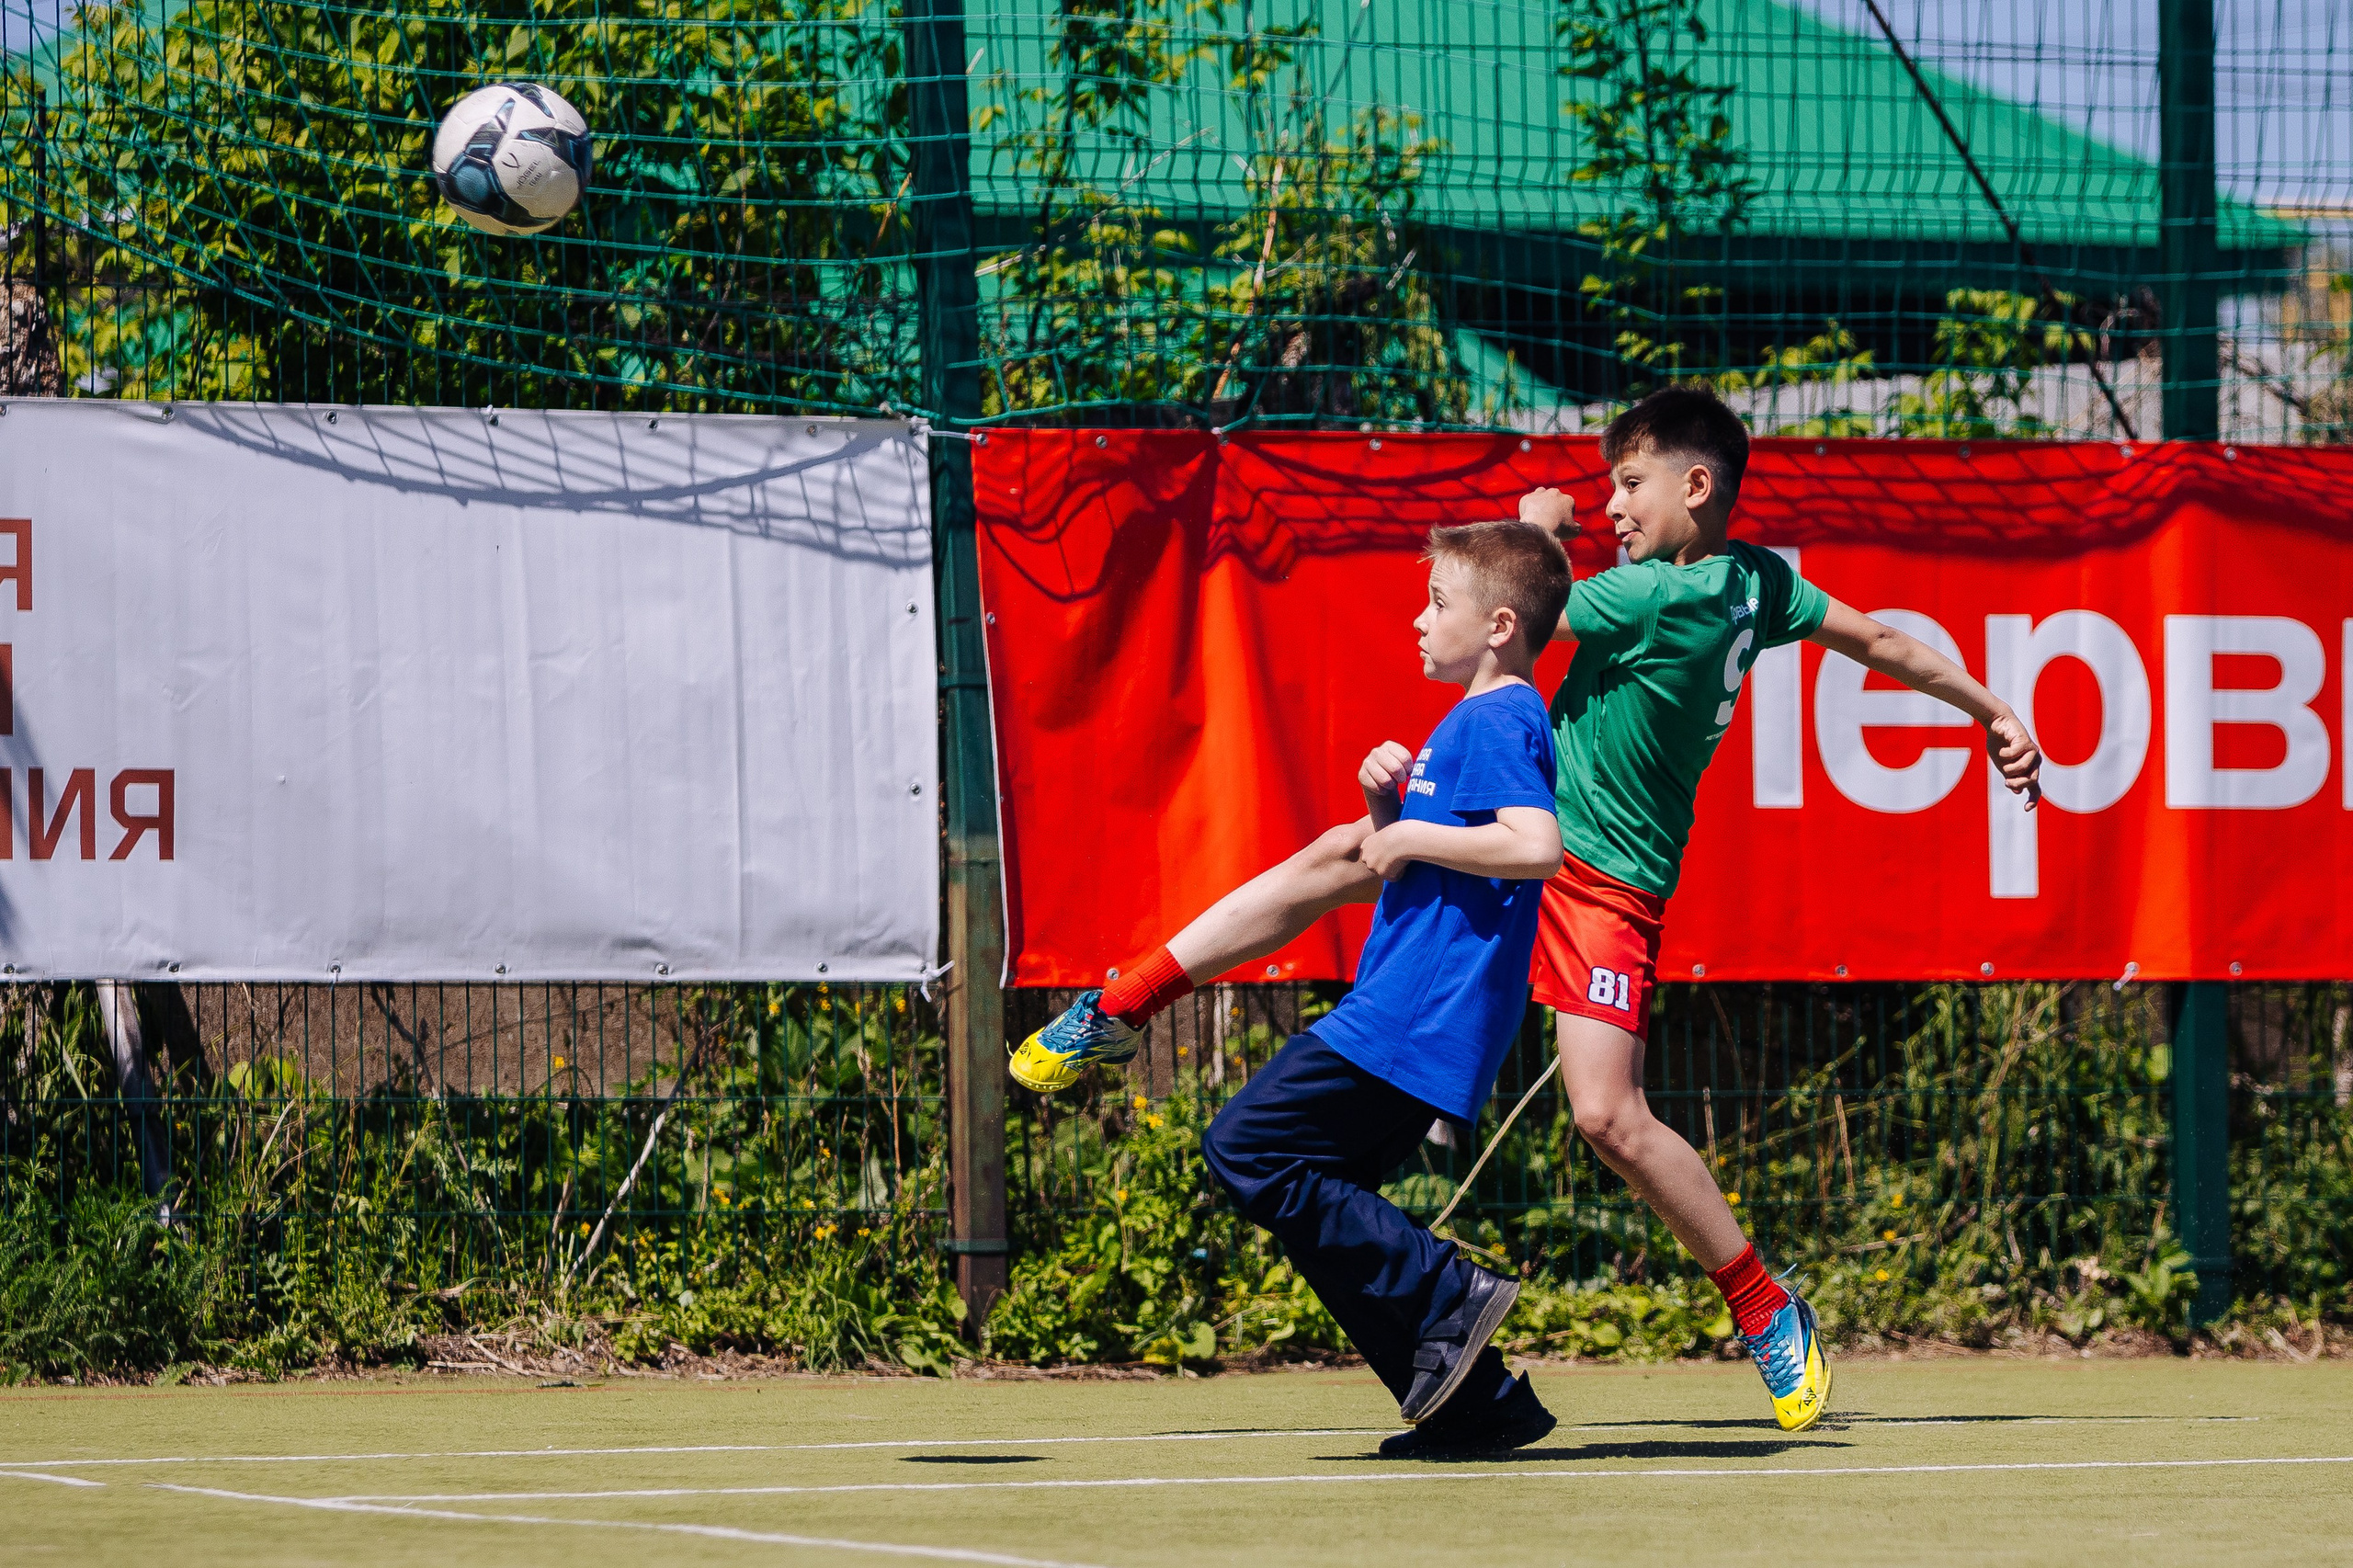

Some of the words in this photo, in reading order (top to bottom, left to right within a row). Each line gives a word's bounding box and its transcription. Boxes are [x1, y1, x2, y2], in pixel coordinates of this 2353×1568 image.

[1730, 597, 1759, 625] рвые
[1617, 546, 2353, 900] ерв
[0, 767, 176, 862] ИЯ
[1587, 966, 1630, 1012] 81
